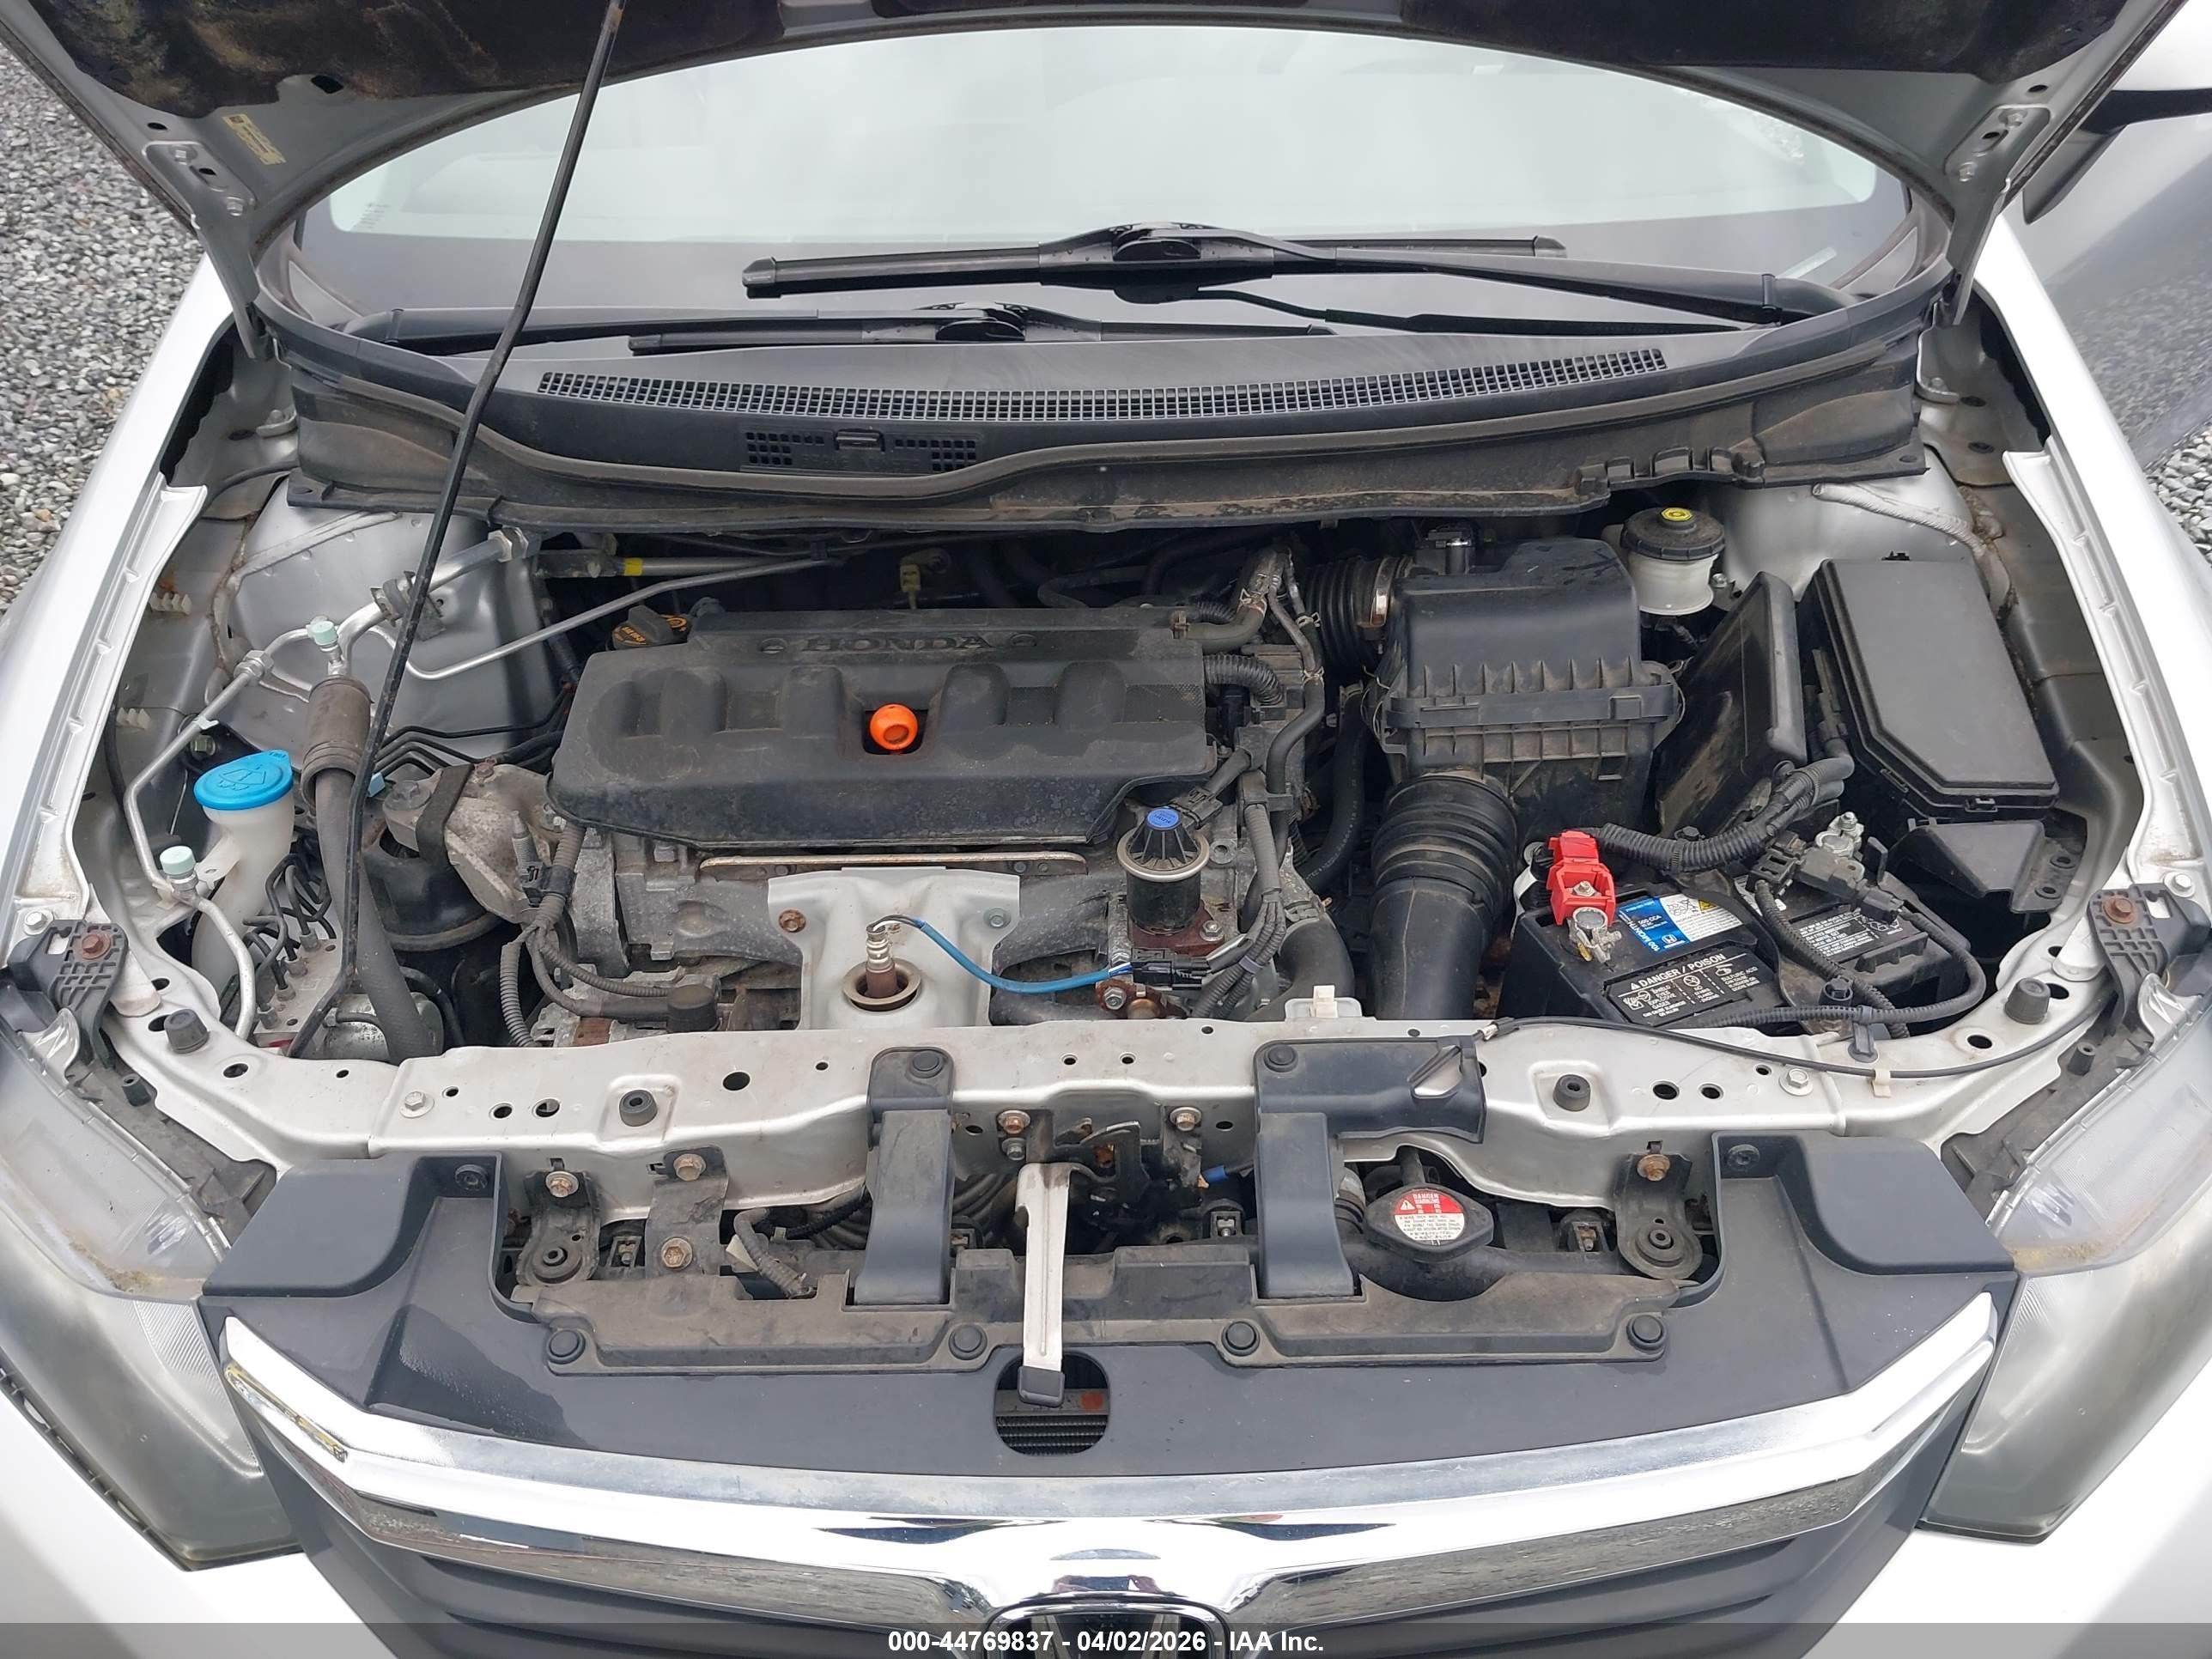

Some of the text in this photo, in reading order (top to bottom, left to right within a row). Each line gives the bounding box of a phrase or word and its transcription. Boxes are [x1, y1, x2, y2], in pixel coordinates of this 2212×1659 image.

[801, 635, 994, 652] HONDA
[1638, 969, 1681, 987] DANGER
[1687, 953, 1726, 970] POISON
